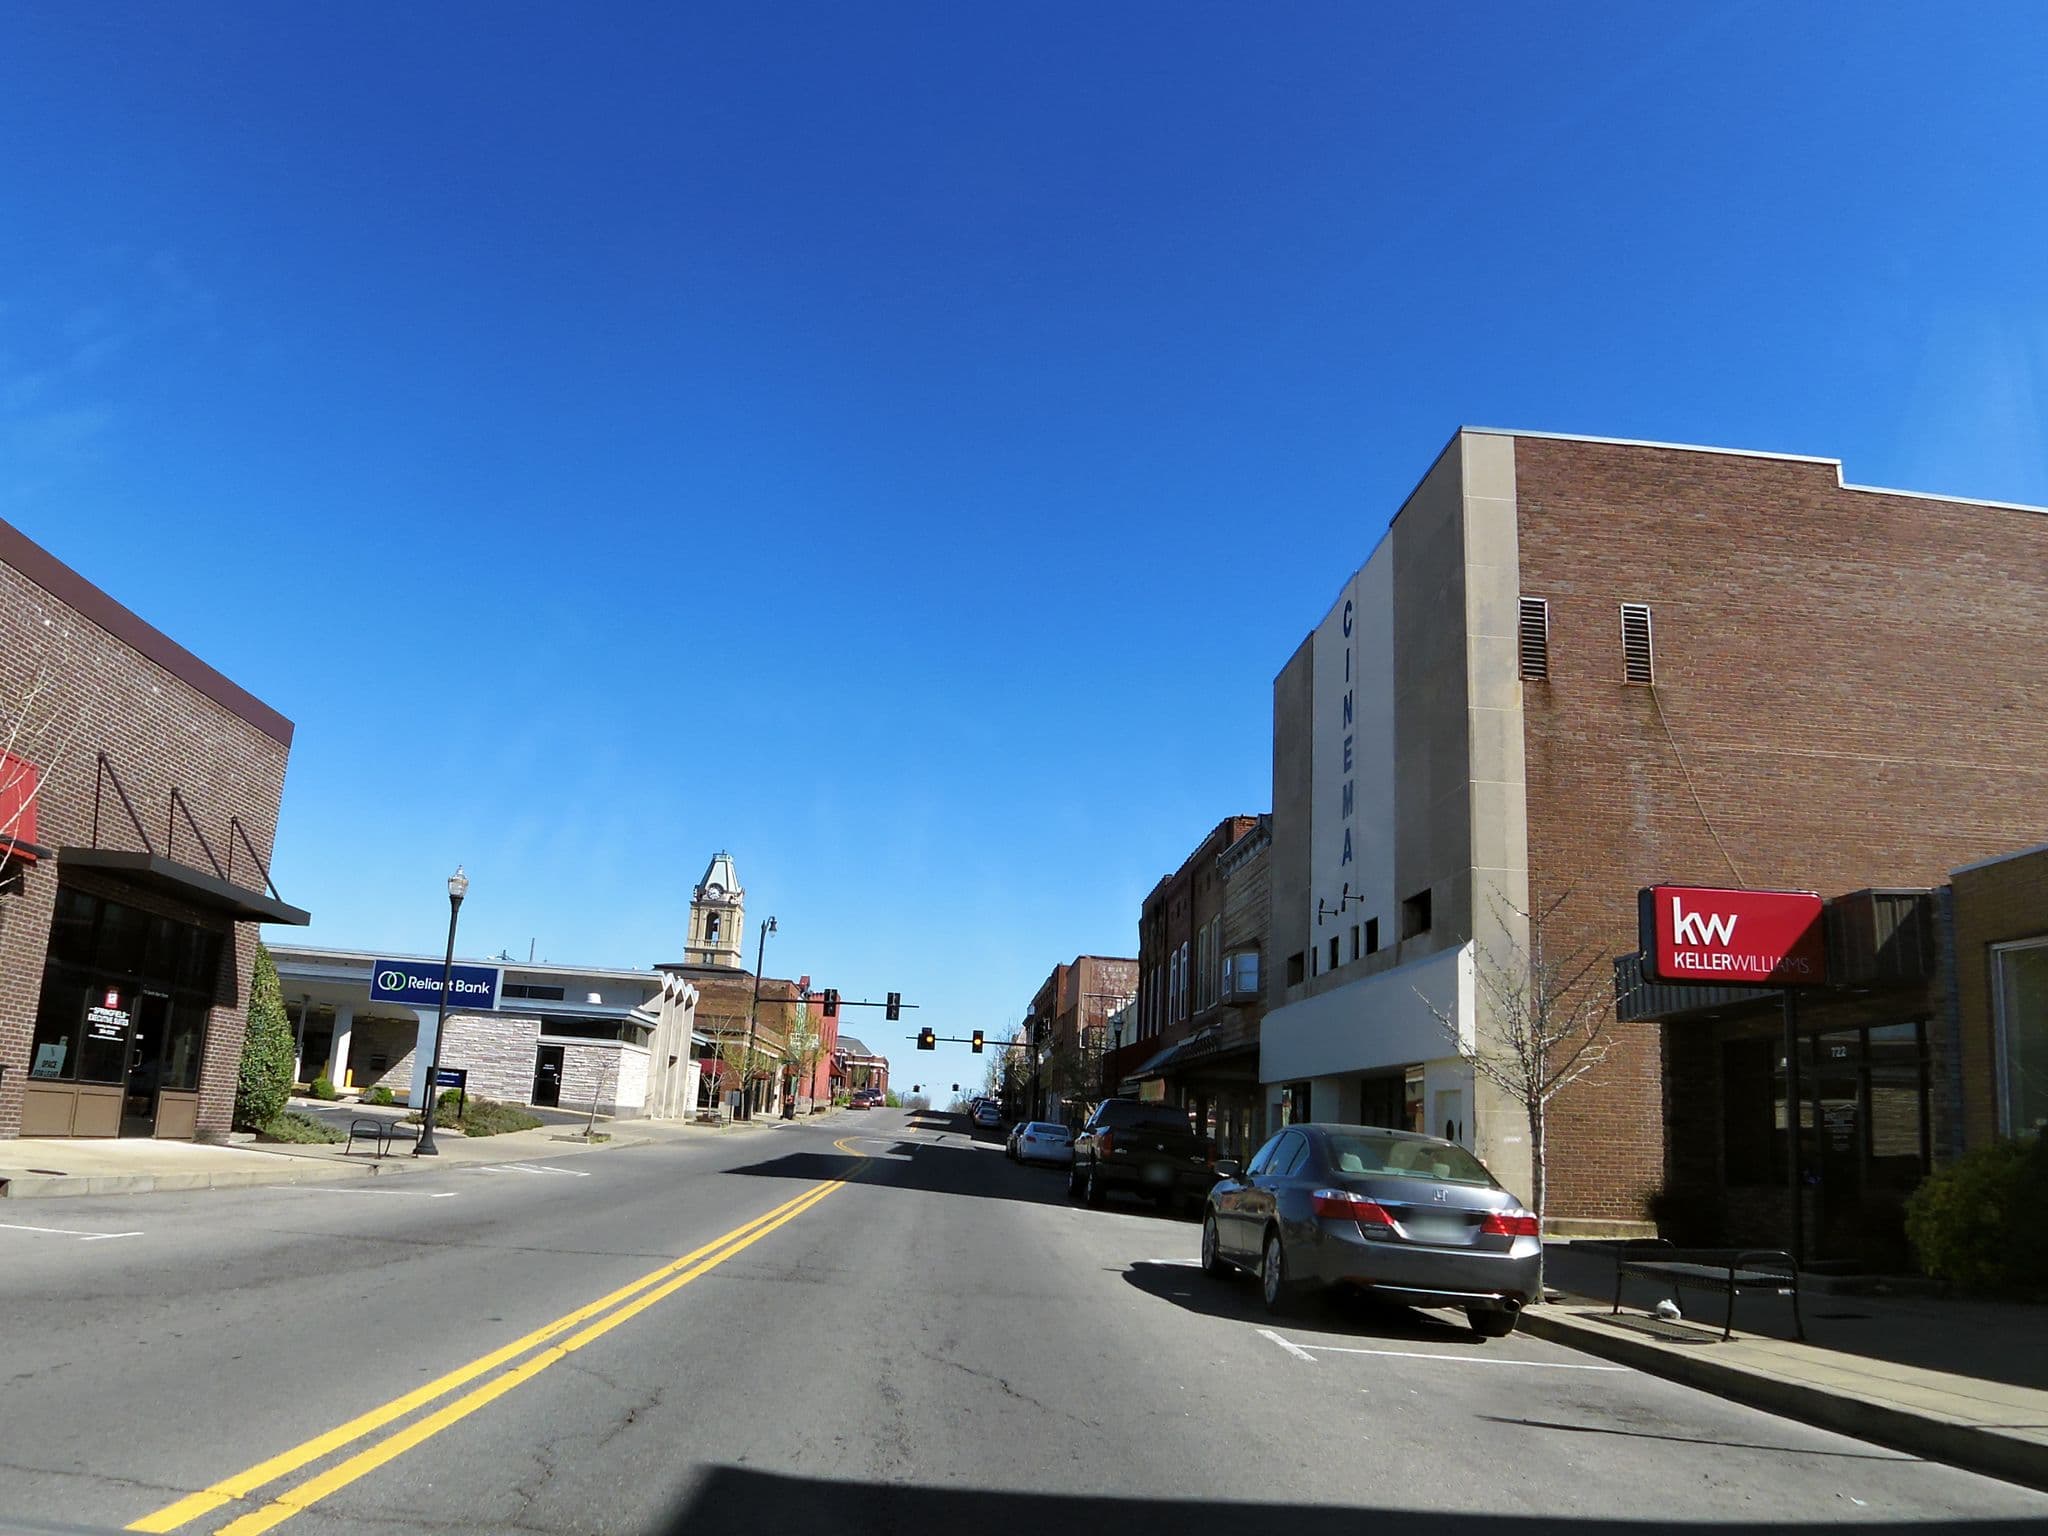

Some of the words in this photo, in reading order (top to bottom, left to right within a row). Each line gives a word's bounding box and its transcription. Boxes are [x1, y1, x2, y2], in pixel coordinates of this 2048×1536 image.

[1342, 599, 1353, 868] CINEMA
[1672, 896, 1738, 946] kw
[455, 979, 491, 995] Bank
